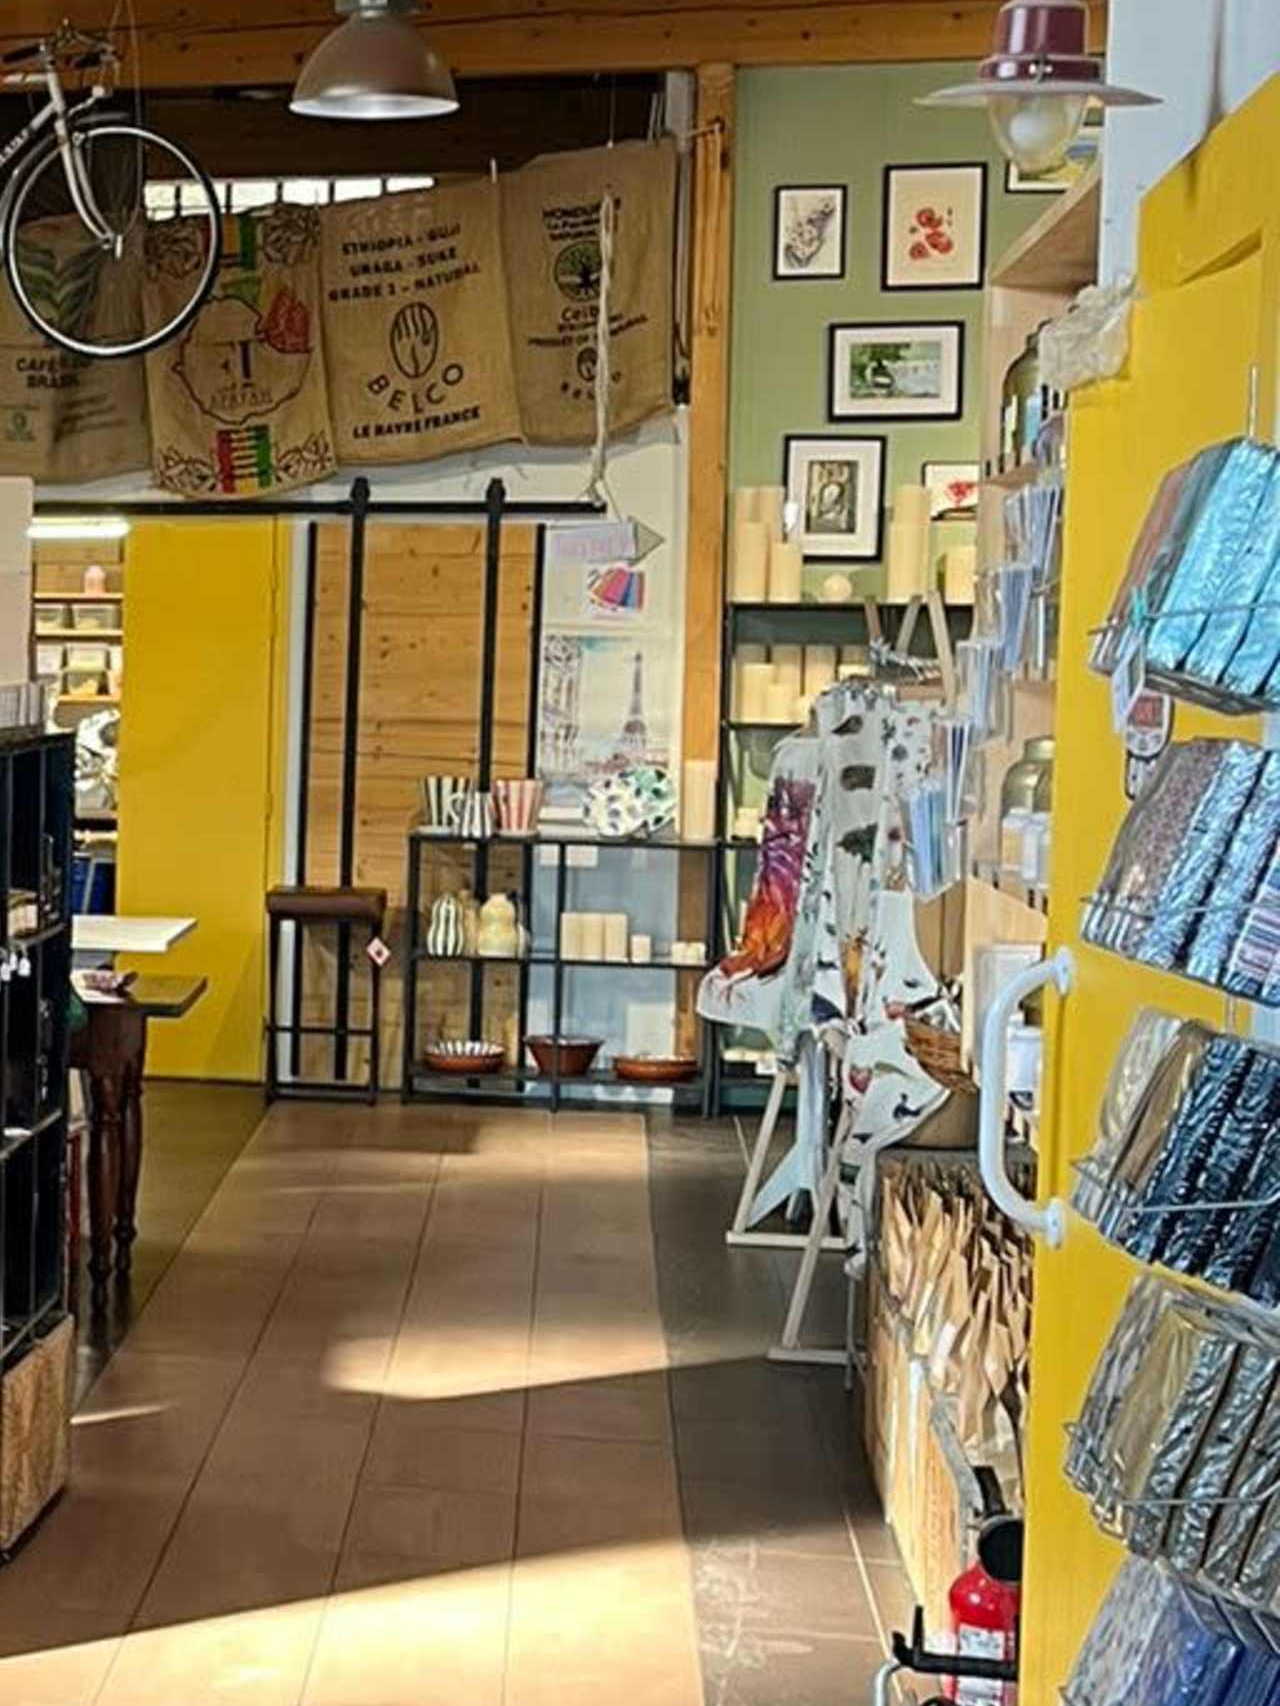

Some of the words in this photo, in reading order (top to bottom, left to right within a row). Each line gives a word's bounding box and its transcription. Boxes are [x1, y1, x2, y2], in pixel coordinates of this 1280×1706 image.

[342, 234, 413, 256] ETHIOPIA
[328, 283, 382, 302] GRADE
[414, 263, 480, 291] NATURAL
[367, 362, 464, 414] BELCO
[353, 422, 370, 439] LE
[424, 406, 481, 430] FRANCE
